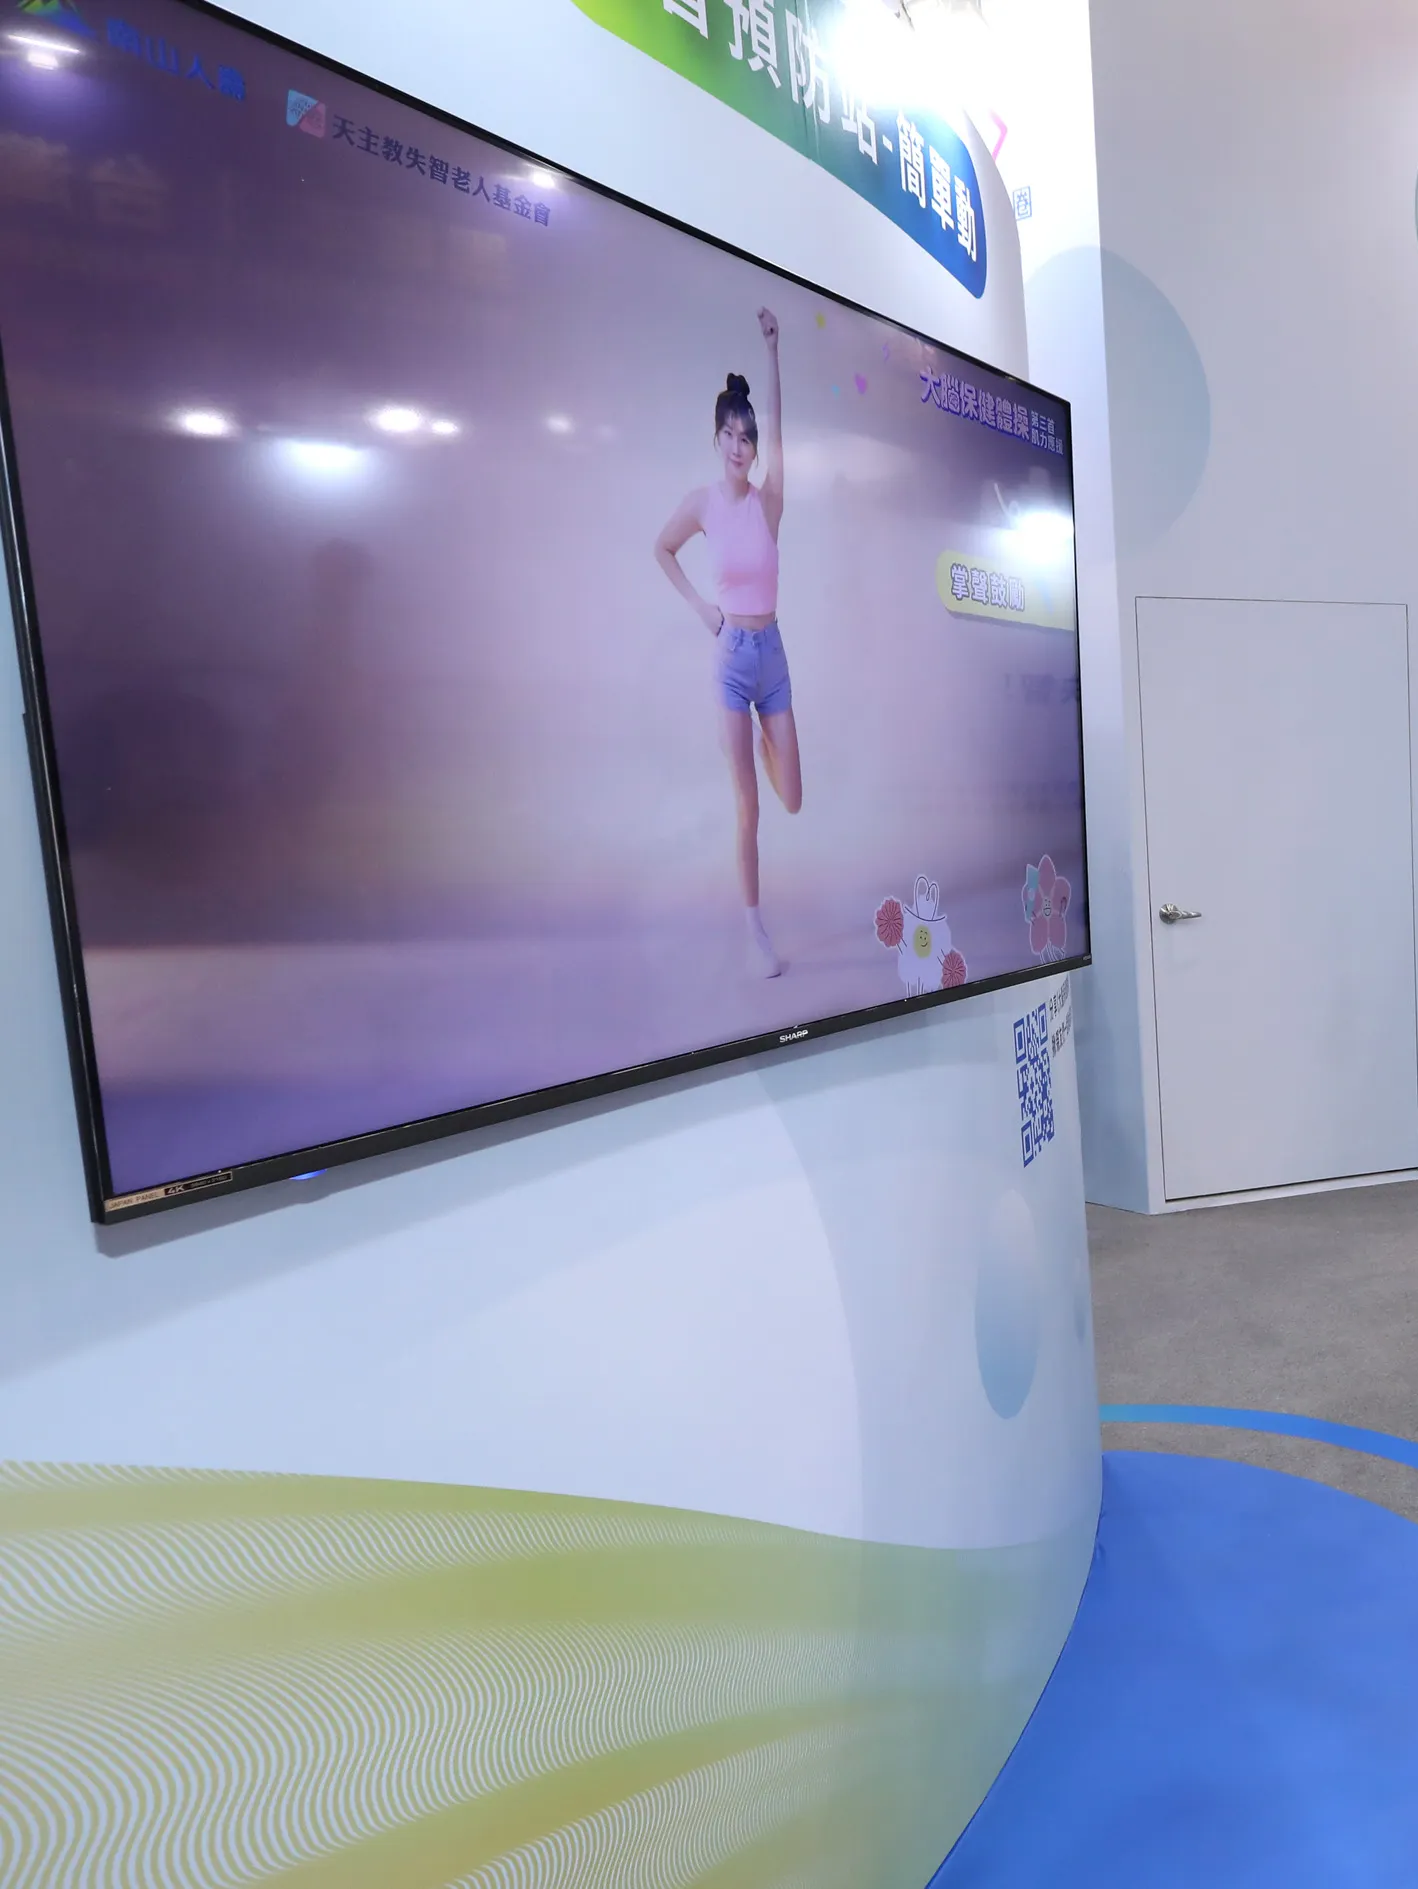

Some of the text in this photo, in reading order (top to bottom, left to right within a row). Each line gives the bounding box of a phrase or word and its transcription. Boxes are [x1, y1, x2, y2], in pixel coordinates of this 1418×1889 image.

[331, 112, 551, 227] 天主教失智老人基金會
[920, 365, 1031, 441] 大腦保健體操
[950, 563, 1026, 612] 掌聲鼓勵
[779, 1029, 809, 1043] SHARP
[167, 1184, 185, 1194] 4K
